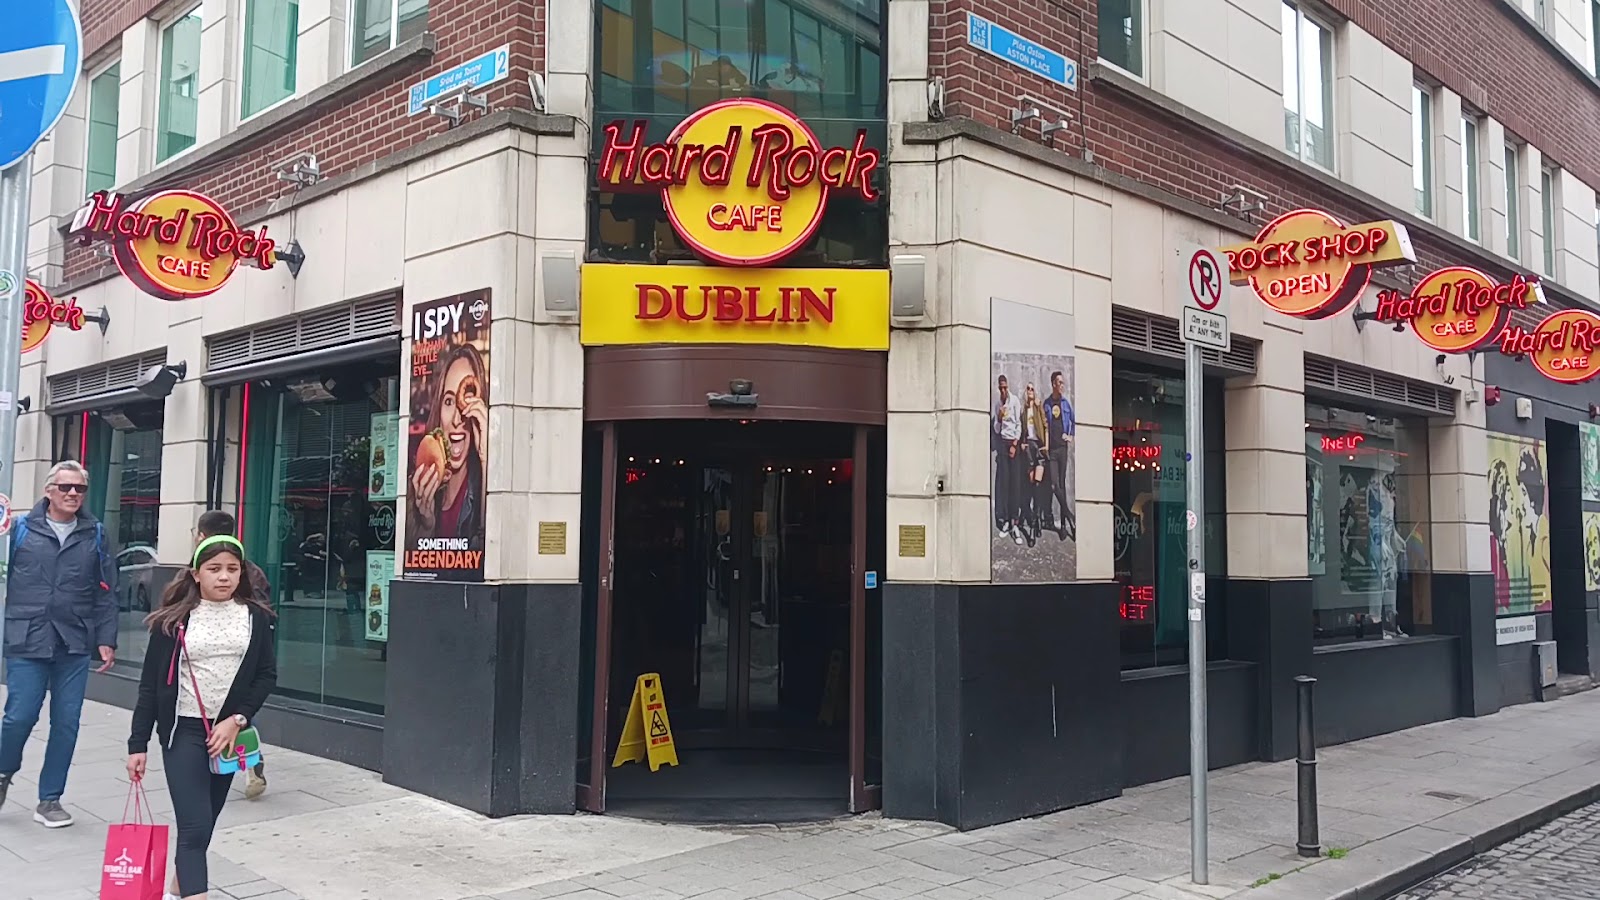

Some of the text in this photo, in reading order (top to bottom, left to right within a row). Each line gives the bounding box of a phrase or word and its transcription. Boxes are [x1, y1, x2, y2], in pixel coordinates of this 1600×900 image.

[973, 18, 986, 30] TEM
[973, 27, 986, 39] PLE
[973, 36, 986, 47] BAR
[497, 51, 507, 74] 2
[1007, 47, 1050, 74] ASTON PLACE
[1067, 64, 1075, 85] 2
[413, 93, 424, 102] PLE
[597, 119, 880, 202] Hard Rock
[707, 202, 783, 233] CAFE
[87, 190, 276, 270] Hard Rock
[1224, 228, 1388, 272] ROCK SHOP
[159, 255, 211, 281] CAFE
[1267, 272, 1331, 299] OPEN
[1377, 273, 1527, 321] Hard Rock
[634, 284, 838, 325] DUBLIN
[414, 302, 465, 341] I SPY
[1431, 320, 1477, 336] CAFE
[1197, 326, 1209, 337] ANY
[1210, 329, 1223, 341] TIME
[1500, 320, 1570, 355] Hard
[413, 351, 438, 365] LITTLE
[1549, 356, 1590, 371] CAFE
[368, 513, 385, 527] Hard
[1114, 516, 1139, 540] Rock
[417, 538, 468, 550] SOMETHING
[404, 550, 483, 569] LEGENDARY
